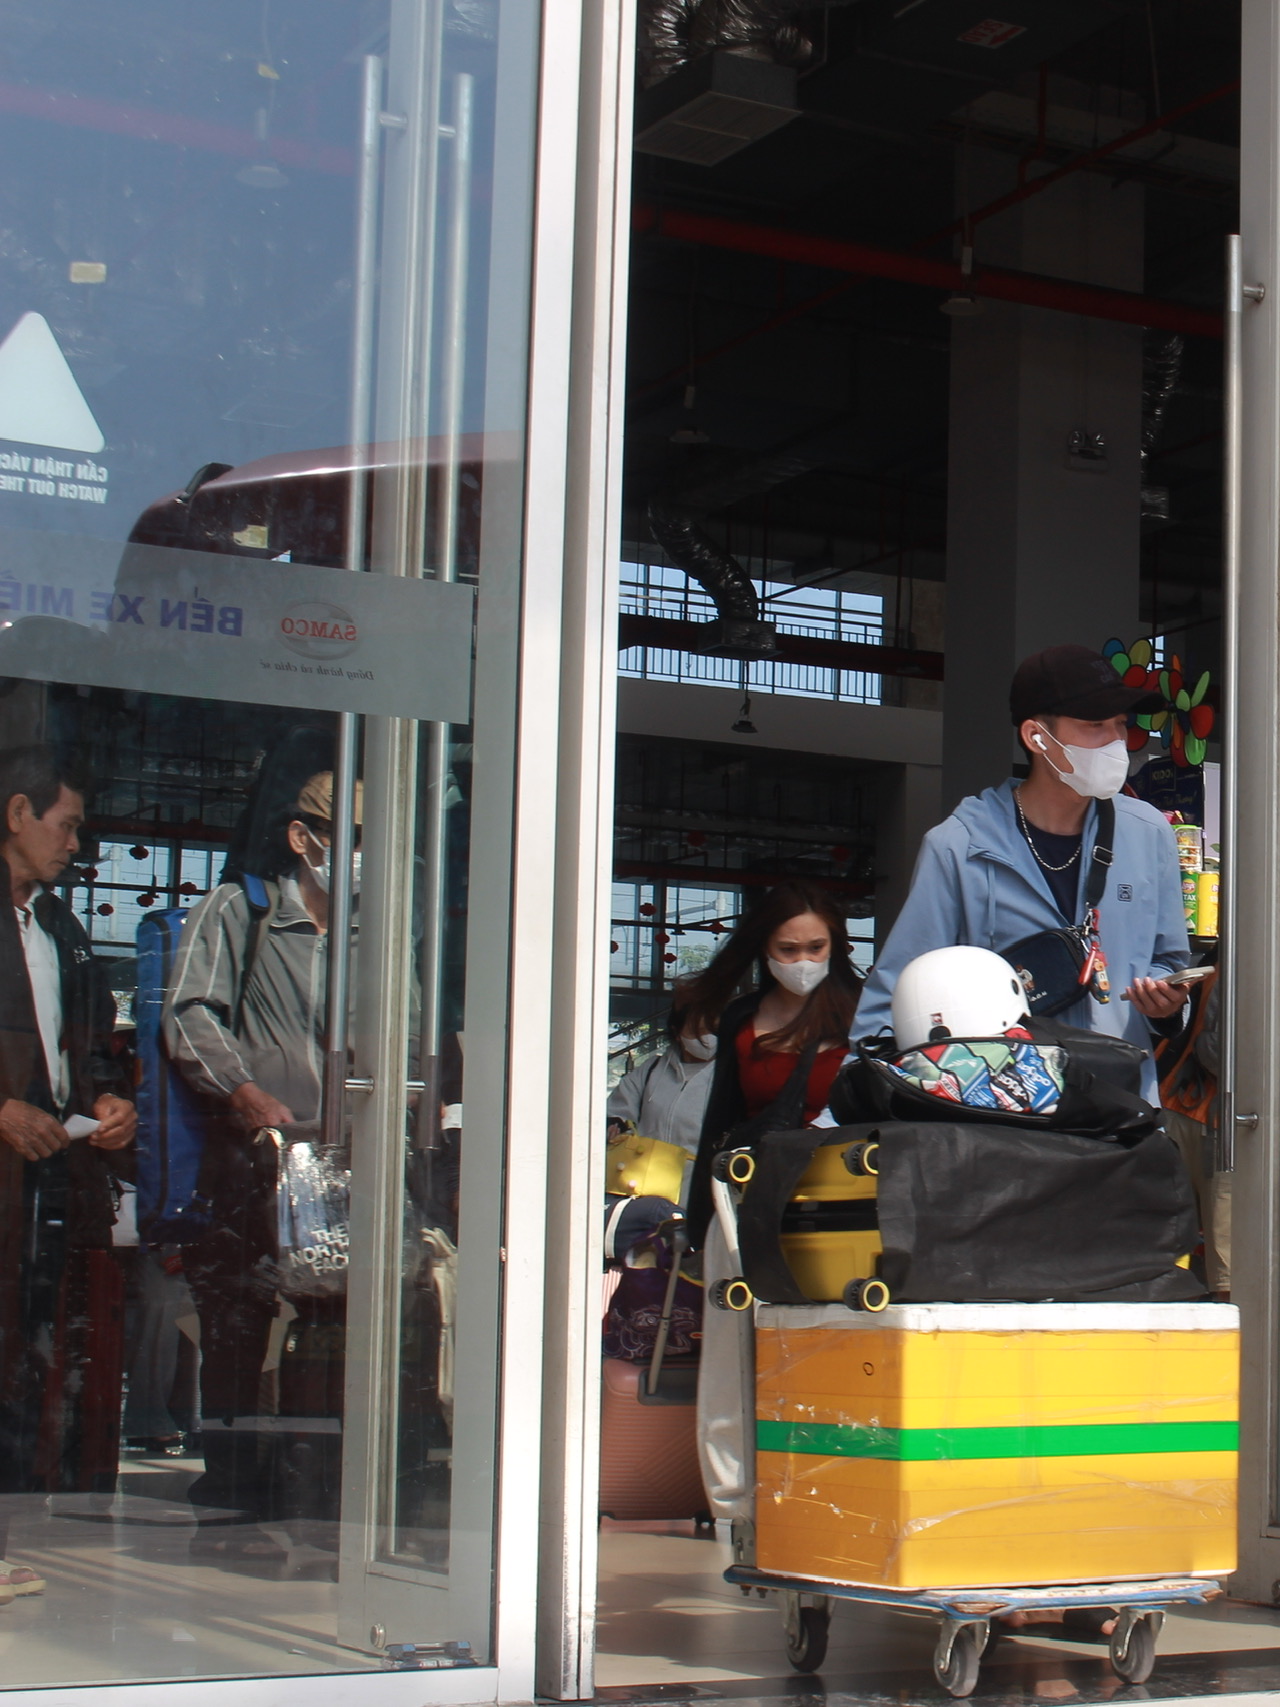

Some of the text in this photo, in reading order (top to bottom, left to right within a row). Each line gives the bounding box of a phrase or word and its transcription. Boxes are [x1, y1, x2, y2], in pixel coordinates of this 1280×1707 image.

[1183, 894, 1197, 902] TAX
[310, 1223, 348, 1243] THE
[312, 1253, 349, 1276] FAC
